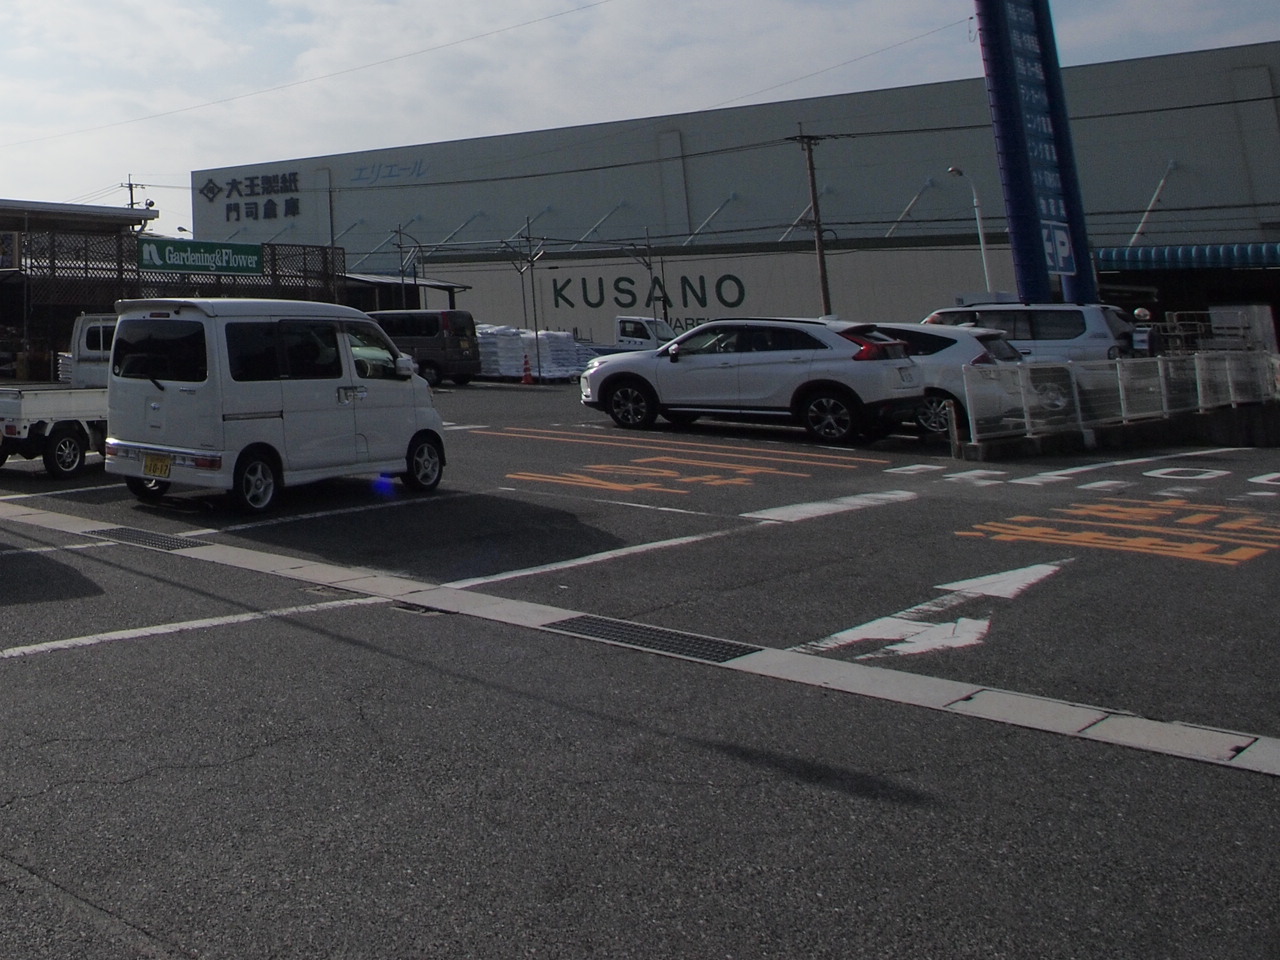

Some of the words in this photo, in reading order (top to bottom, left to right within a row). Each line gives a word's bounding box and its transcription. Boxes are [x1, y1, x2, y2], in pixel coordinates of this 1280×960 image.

[226, 172, 299, 198] 大王製紙
[226, 197, 300, 222] 門司倉庫
[165, 246, 258, 271] Gardening&Flower
[553, 274, 746, 308] KUSANO
